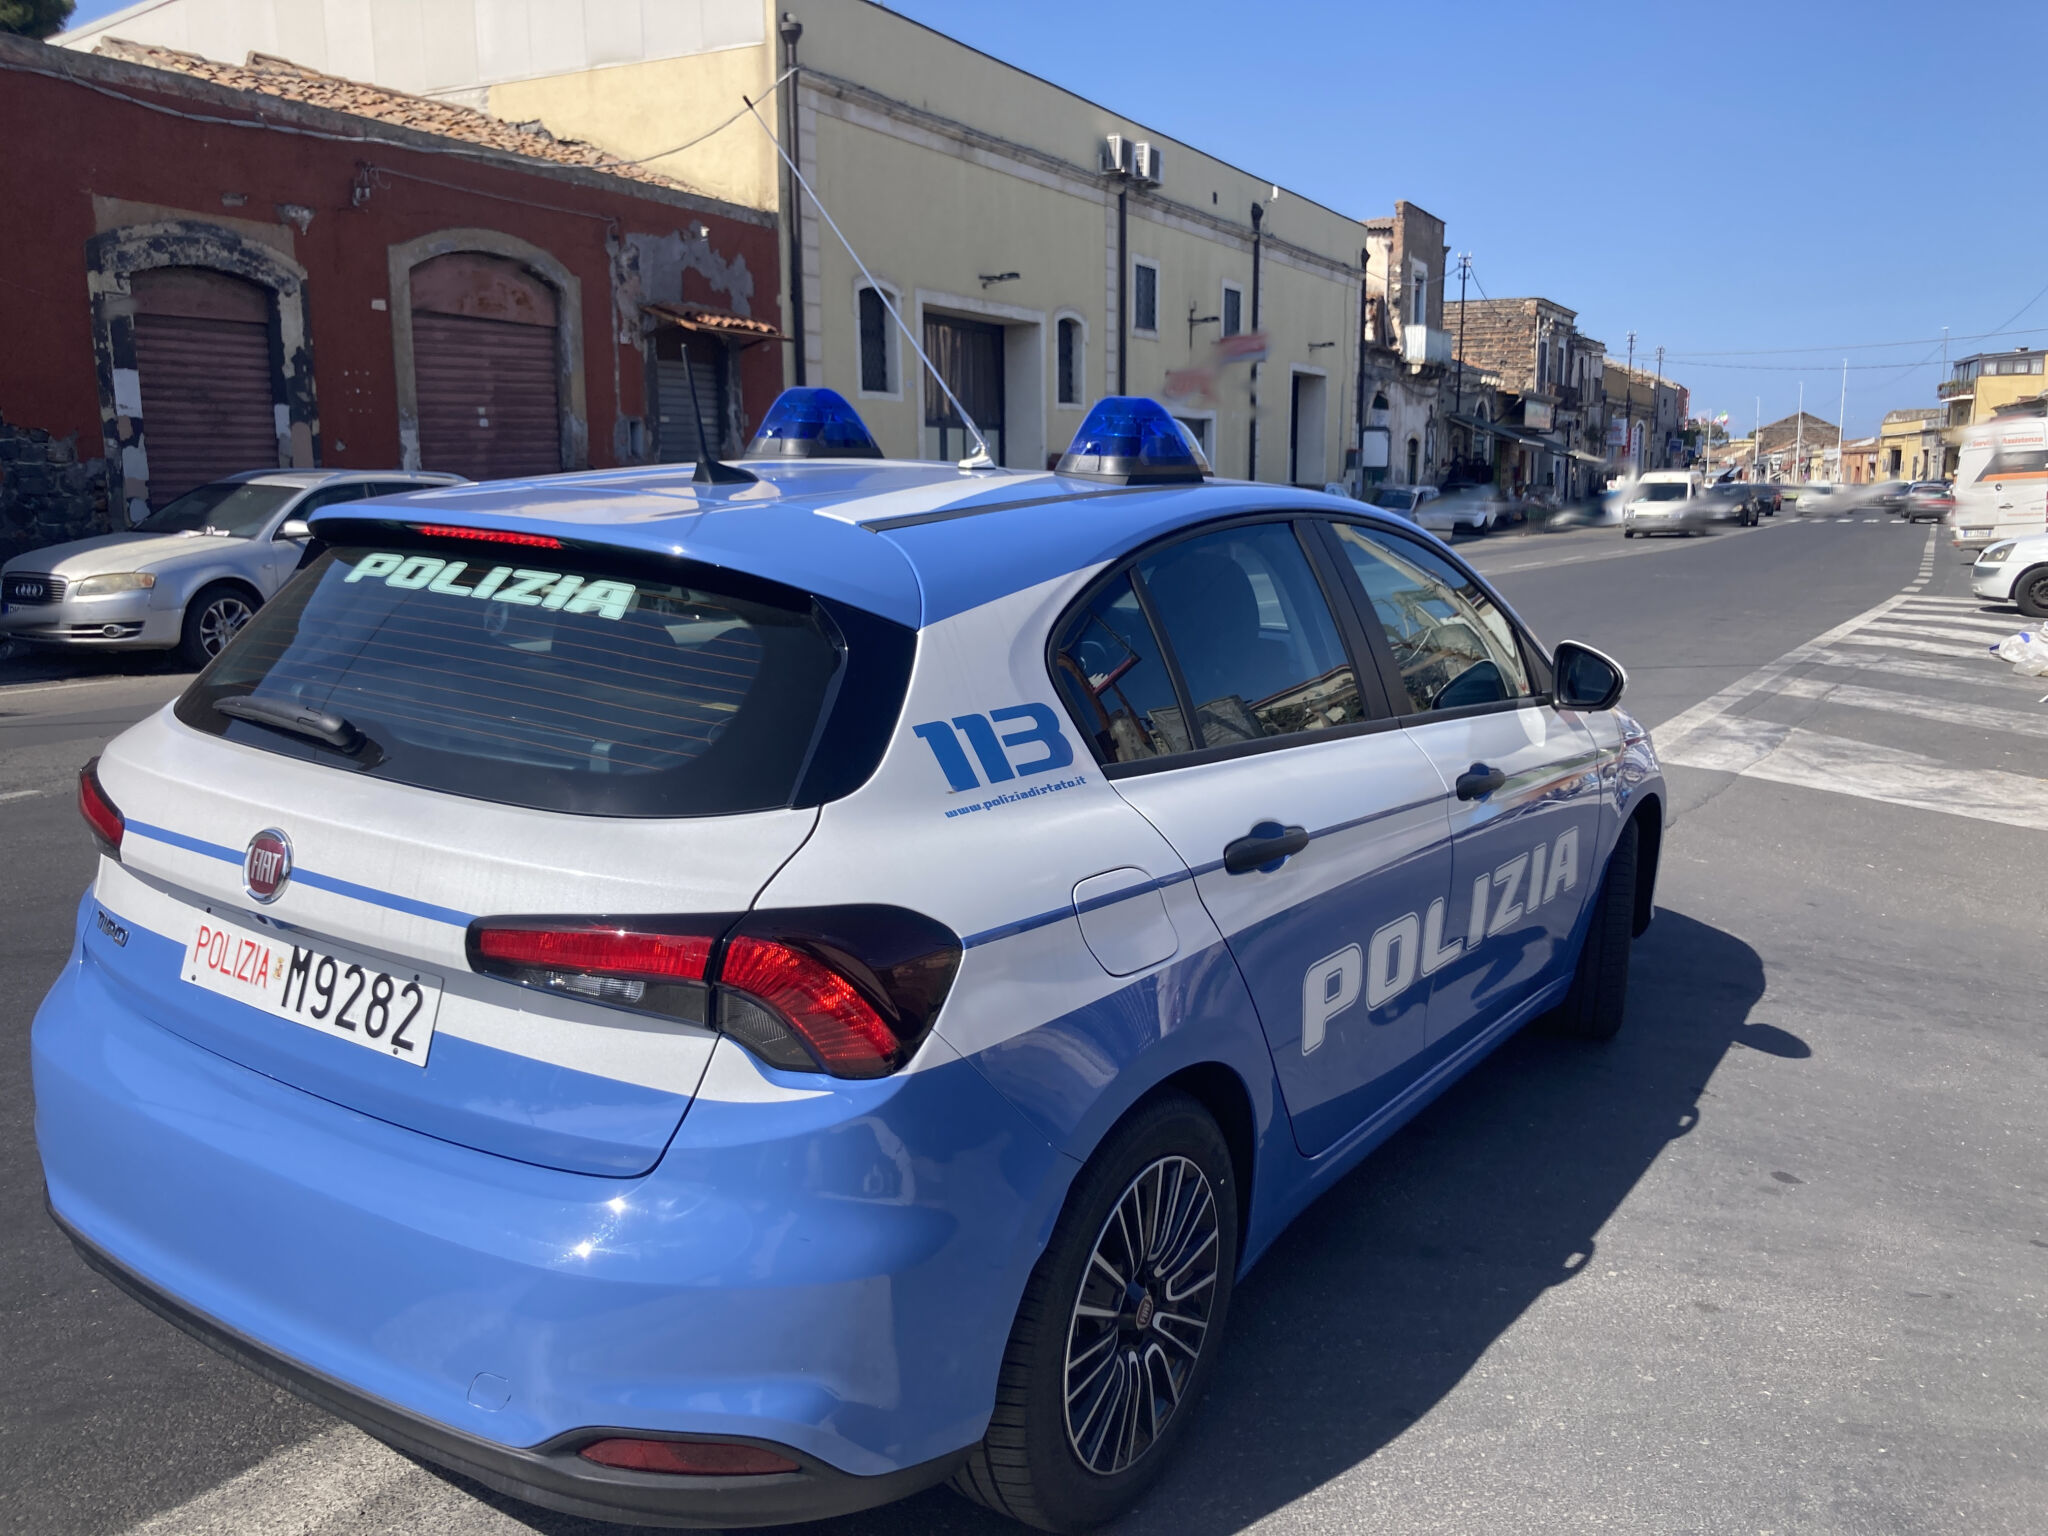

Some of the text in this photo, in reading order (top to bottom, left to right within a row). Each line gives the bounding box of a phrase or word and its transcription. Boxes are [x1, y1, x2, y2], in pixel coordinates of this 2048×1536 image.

[344, 552, 636, 621] POLIZIA
[912, 702, 1073, 792] 113
[945, 776, 1087, 818] www.poliziadistato.it
[251, 847, 282, 884] FIAT
[97, 910, 129, 948] TIPO
[1302, 826, 1579, 1056] POLIZIA
[194, 925, 424, 1052] POLIZIA M9282
